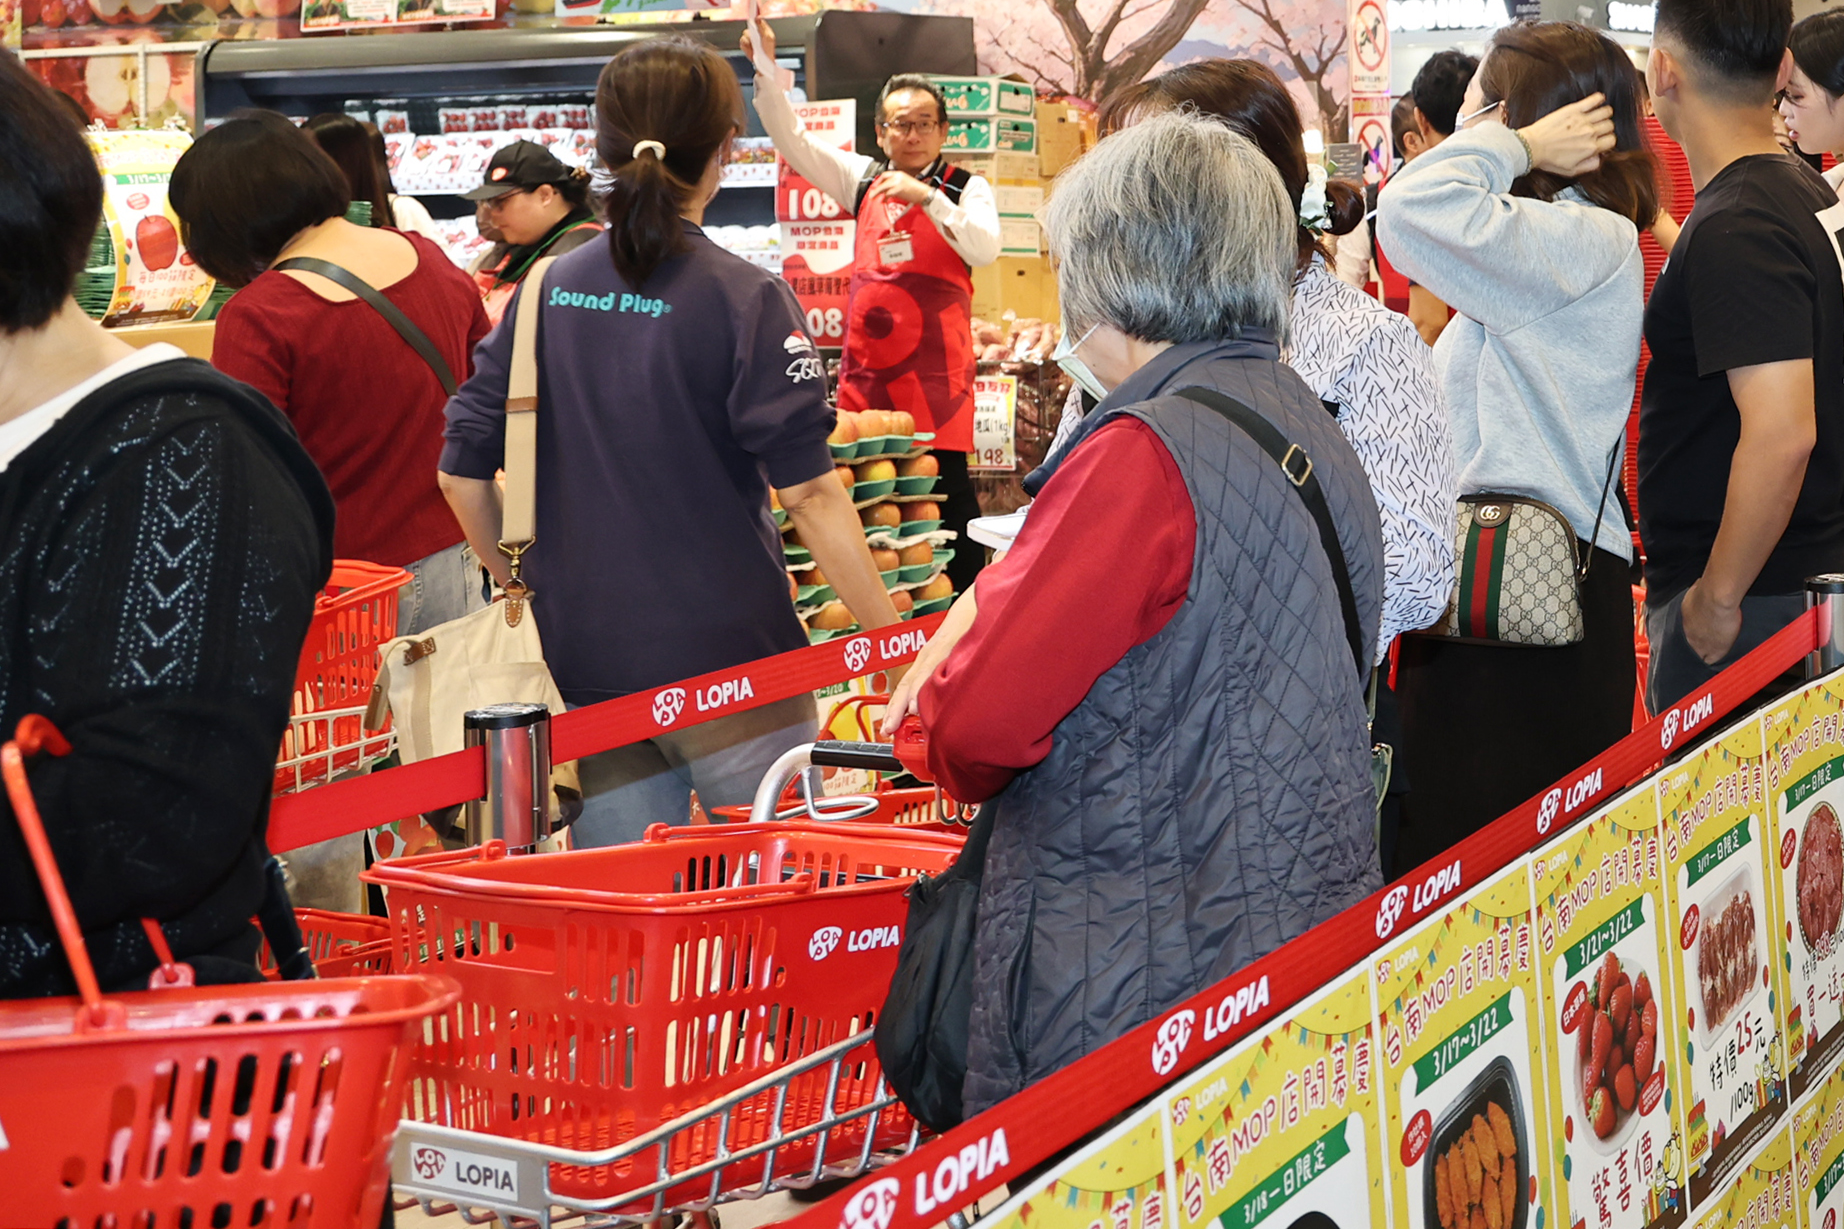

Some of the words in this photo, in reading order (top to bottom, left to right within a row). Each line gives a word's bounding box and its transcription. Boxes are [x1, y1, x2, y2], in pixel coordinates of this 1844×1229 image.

[549, 286, 616, 311] Sound
[619, 293, 663, 318] Plug
[695, 676, 754, 712] LOPIA
[1682, 692, 1713, 733] LOPIA
[1563, 767, 1604, 813] LOPIA
[1667, 762, 1762, 863] 台南MOP店開幕慶
[1411, 860, 1462, 913] LOPIA
[1541, 835, 1657, 956] 台南MOP店開幕慶
[847, 926, 900, 953] LOPIA
[1393, 946, 1419, 971] LOPIA
[1578, 909, 1634, 966] 3/21~3/22
[1203, 975, 1270, 1042] LOPIA
[1383, 921, 1531, 1067] 台南MOP店開幕慶
[1432, 1008, 1500, 1077] 3/17~3/22
[1195, 1077, 1228, 1111] LOPIA
[1182, 1037, 1371, 1223] 台南MOP店開幕慶
[455, 1161, 515, 1193] LOPIA
[914, 1127, 1011, 1216] LOPIA
